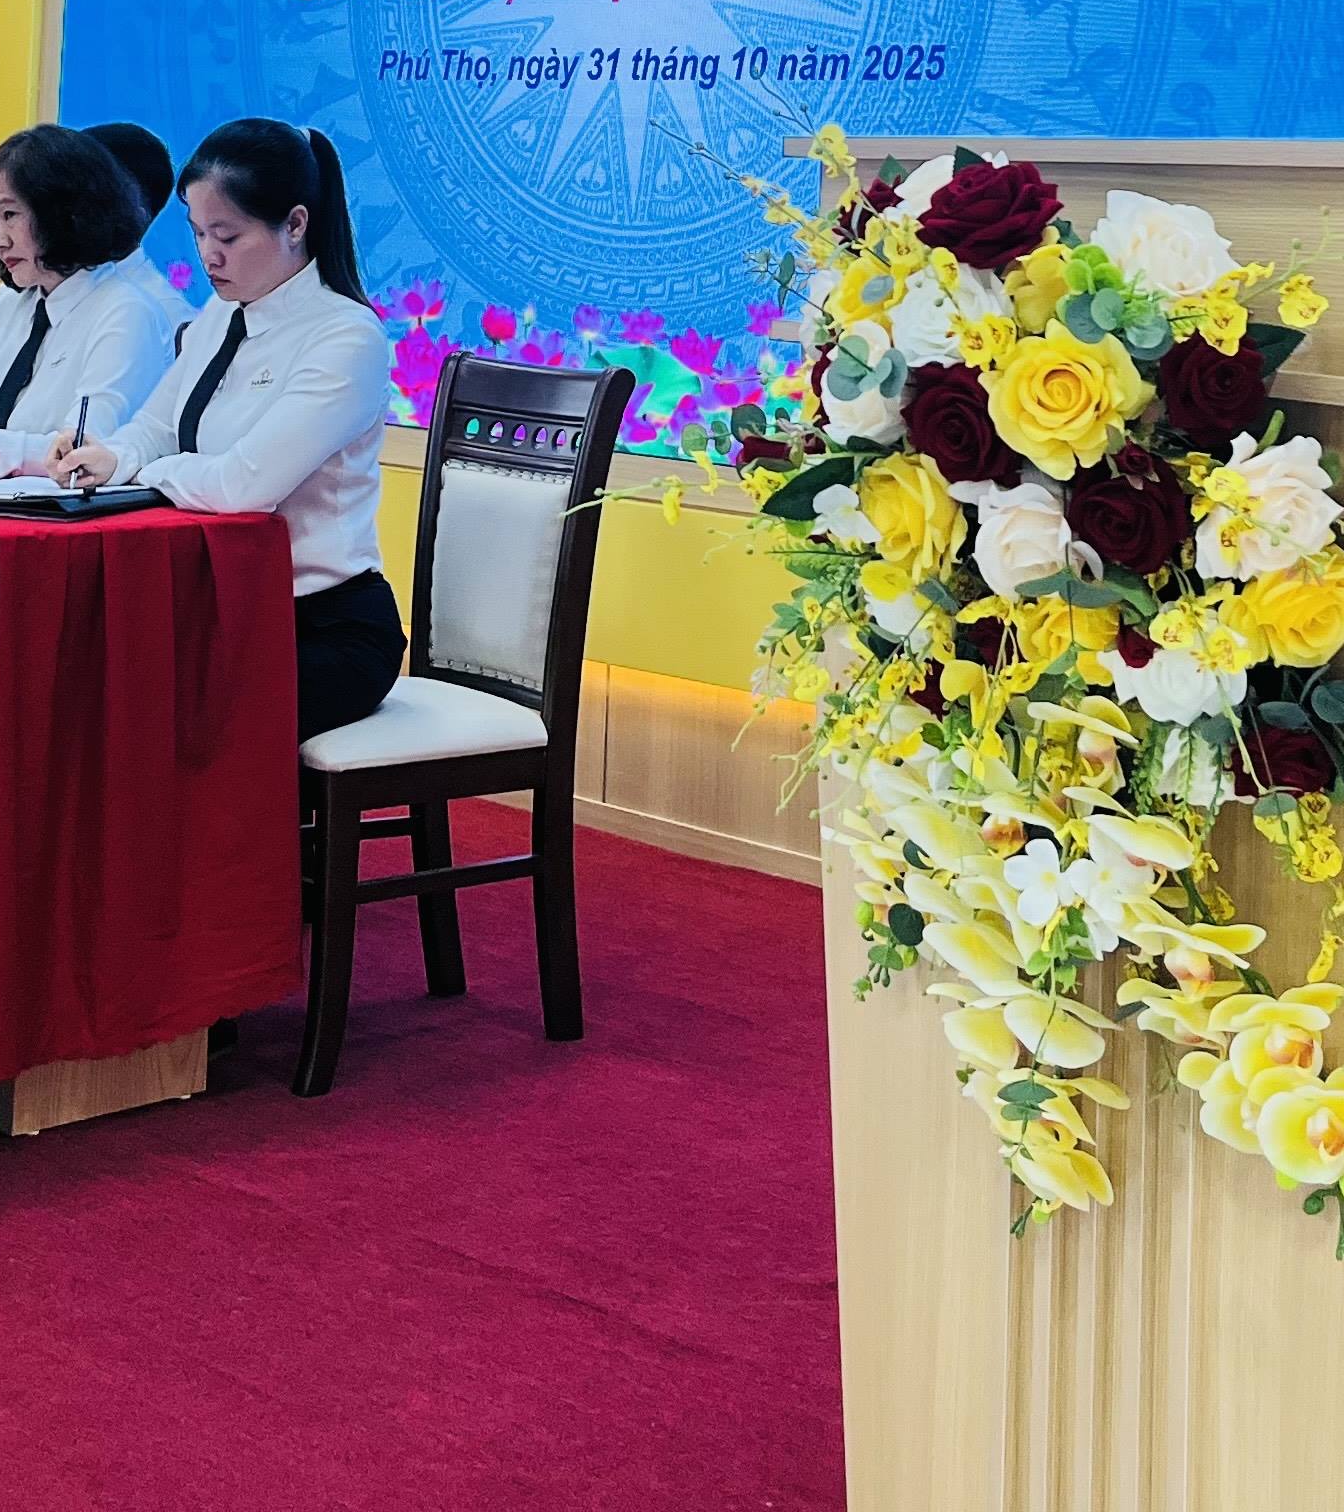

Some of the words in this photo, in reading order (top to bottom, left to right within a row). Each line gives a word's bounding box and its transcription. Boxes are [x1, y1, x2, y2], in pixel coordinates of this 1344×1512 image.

[377, 49, 432, 82] Phú
[440, 48, 498, 88] Thọ,
[506, 49, 579, 91] ngày
[586, 47, 622, 82] 31
[631, 45, 721, 91] tháng
[731, 45, 770, 82] 10
[776, 44, 852, 81] năm
[860, 43, 947, 82] 2025
